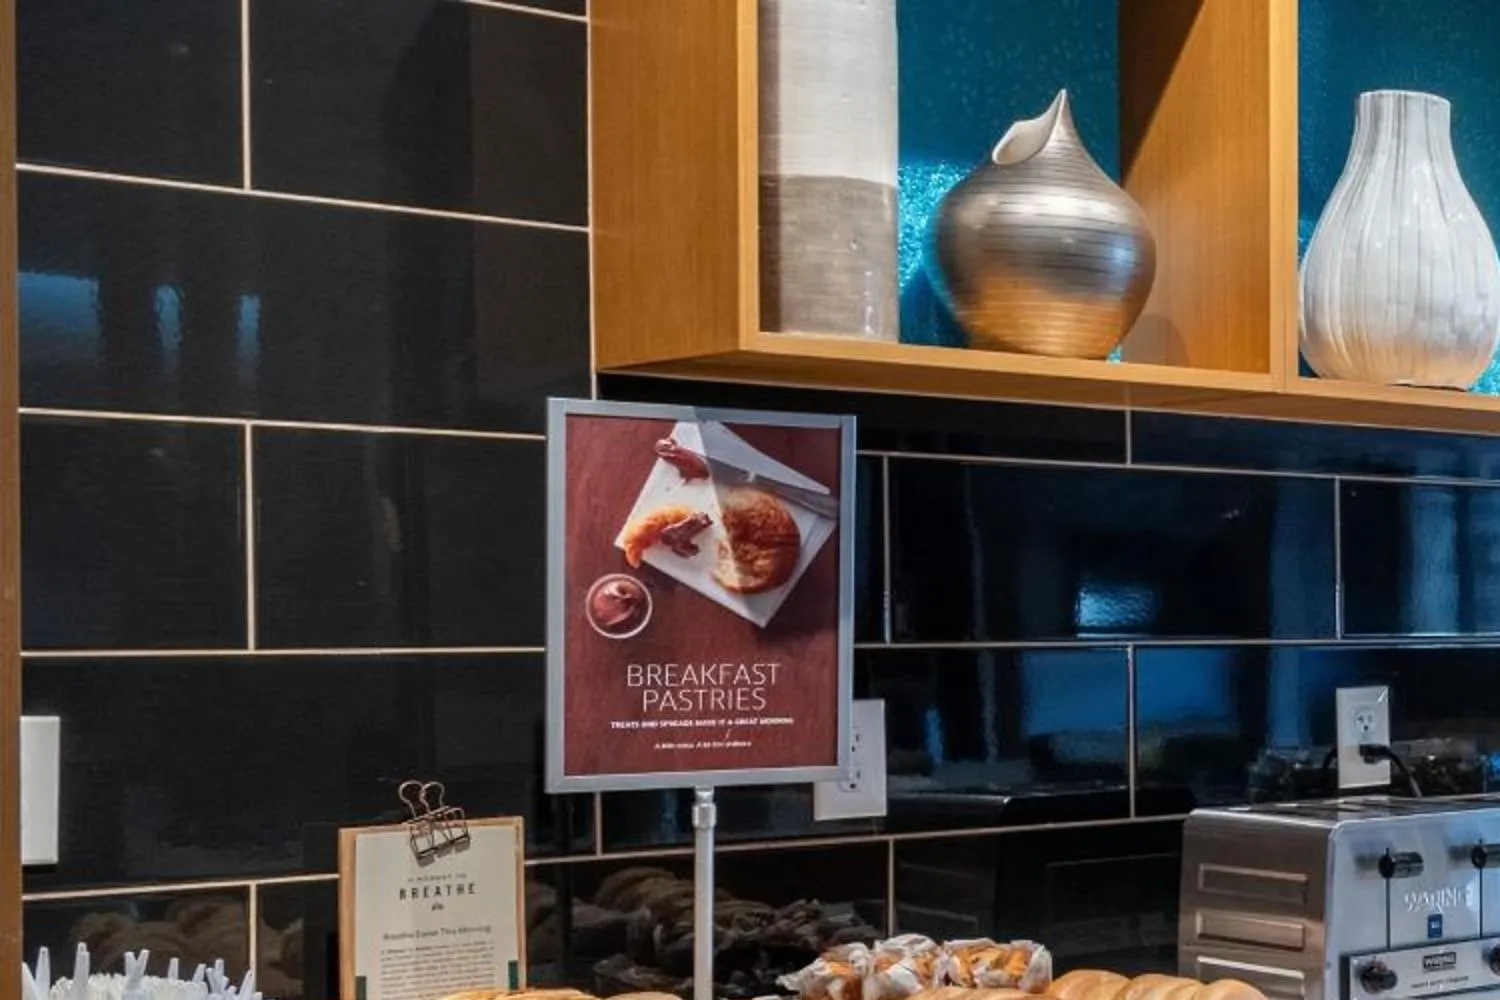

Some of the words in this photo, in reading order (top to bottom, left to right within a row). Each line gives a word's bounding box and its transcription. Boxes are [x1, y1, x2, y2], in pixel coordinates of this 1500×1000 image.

[627, 663, 781, 687] BREAKFAST
[642, 687, 767, 713] PASTRIES
[399, 883, 475, 900] BREATHE
